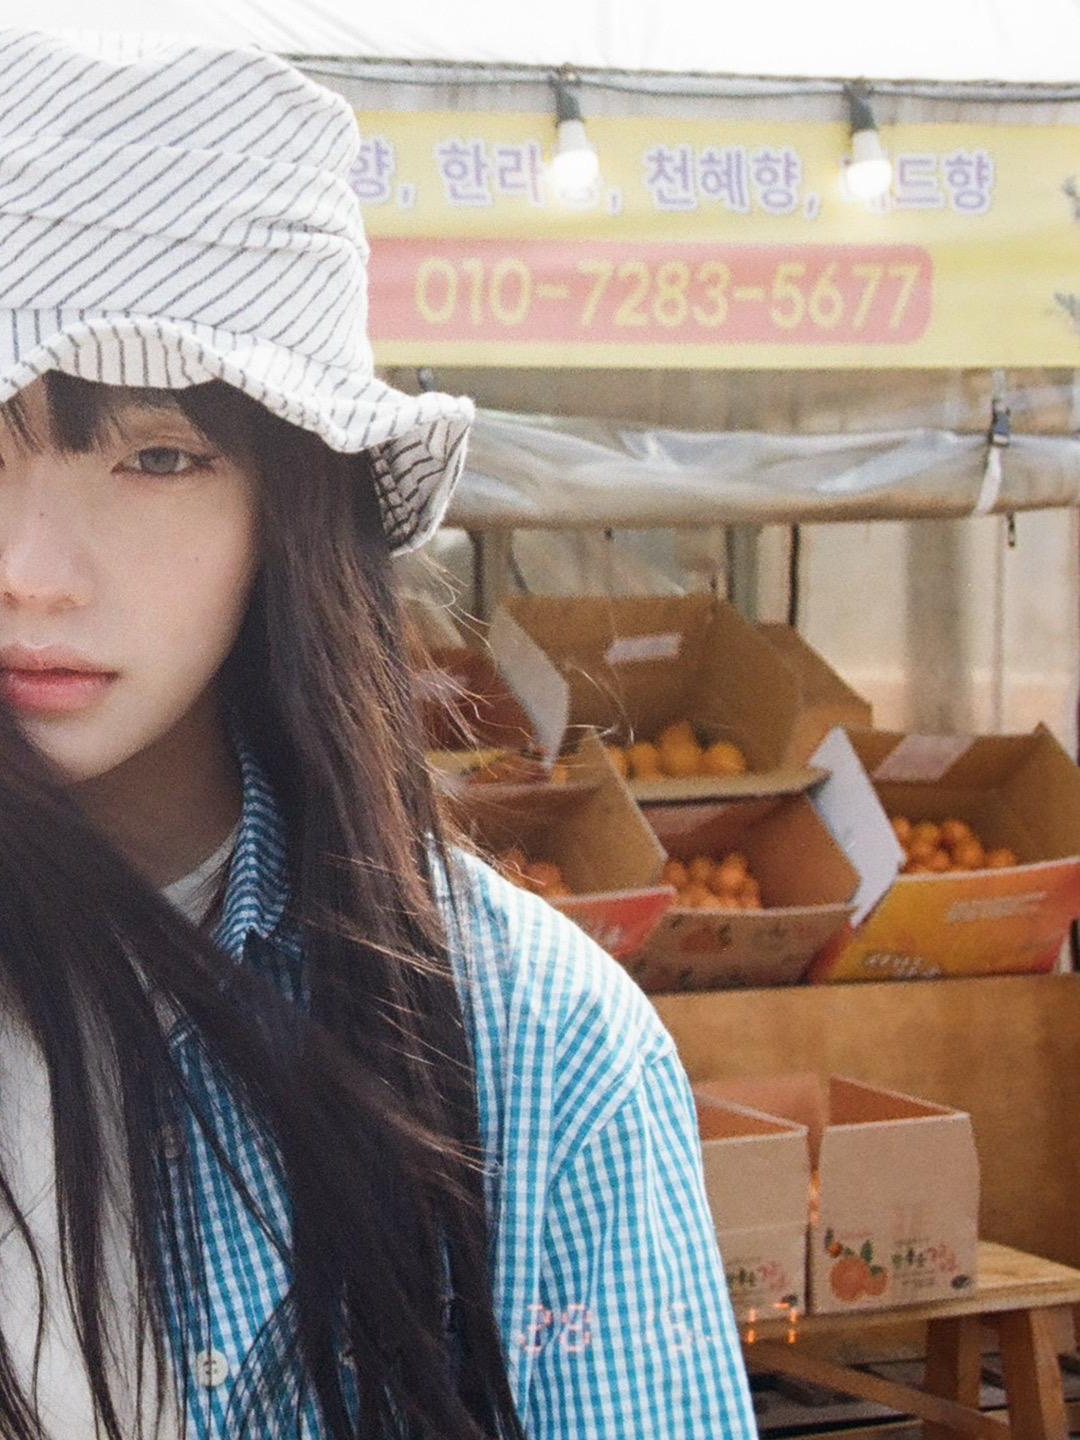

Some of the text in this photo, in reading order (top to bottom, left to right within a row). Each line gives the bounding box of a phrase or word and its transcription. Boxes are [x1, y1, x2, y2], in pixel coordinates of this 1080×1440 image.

[436, 138, 619, 211] 한라,
[647, 144, 819, 216] 천혜향,
[842, 150, 994, 213] 드향
[415, 256, 920, 330] 010-7283-5677
